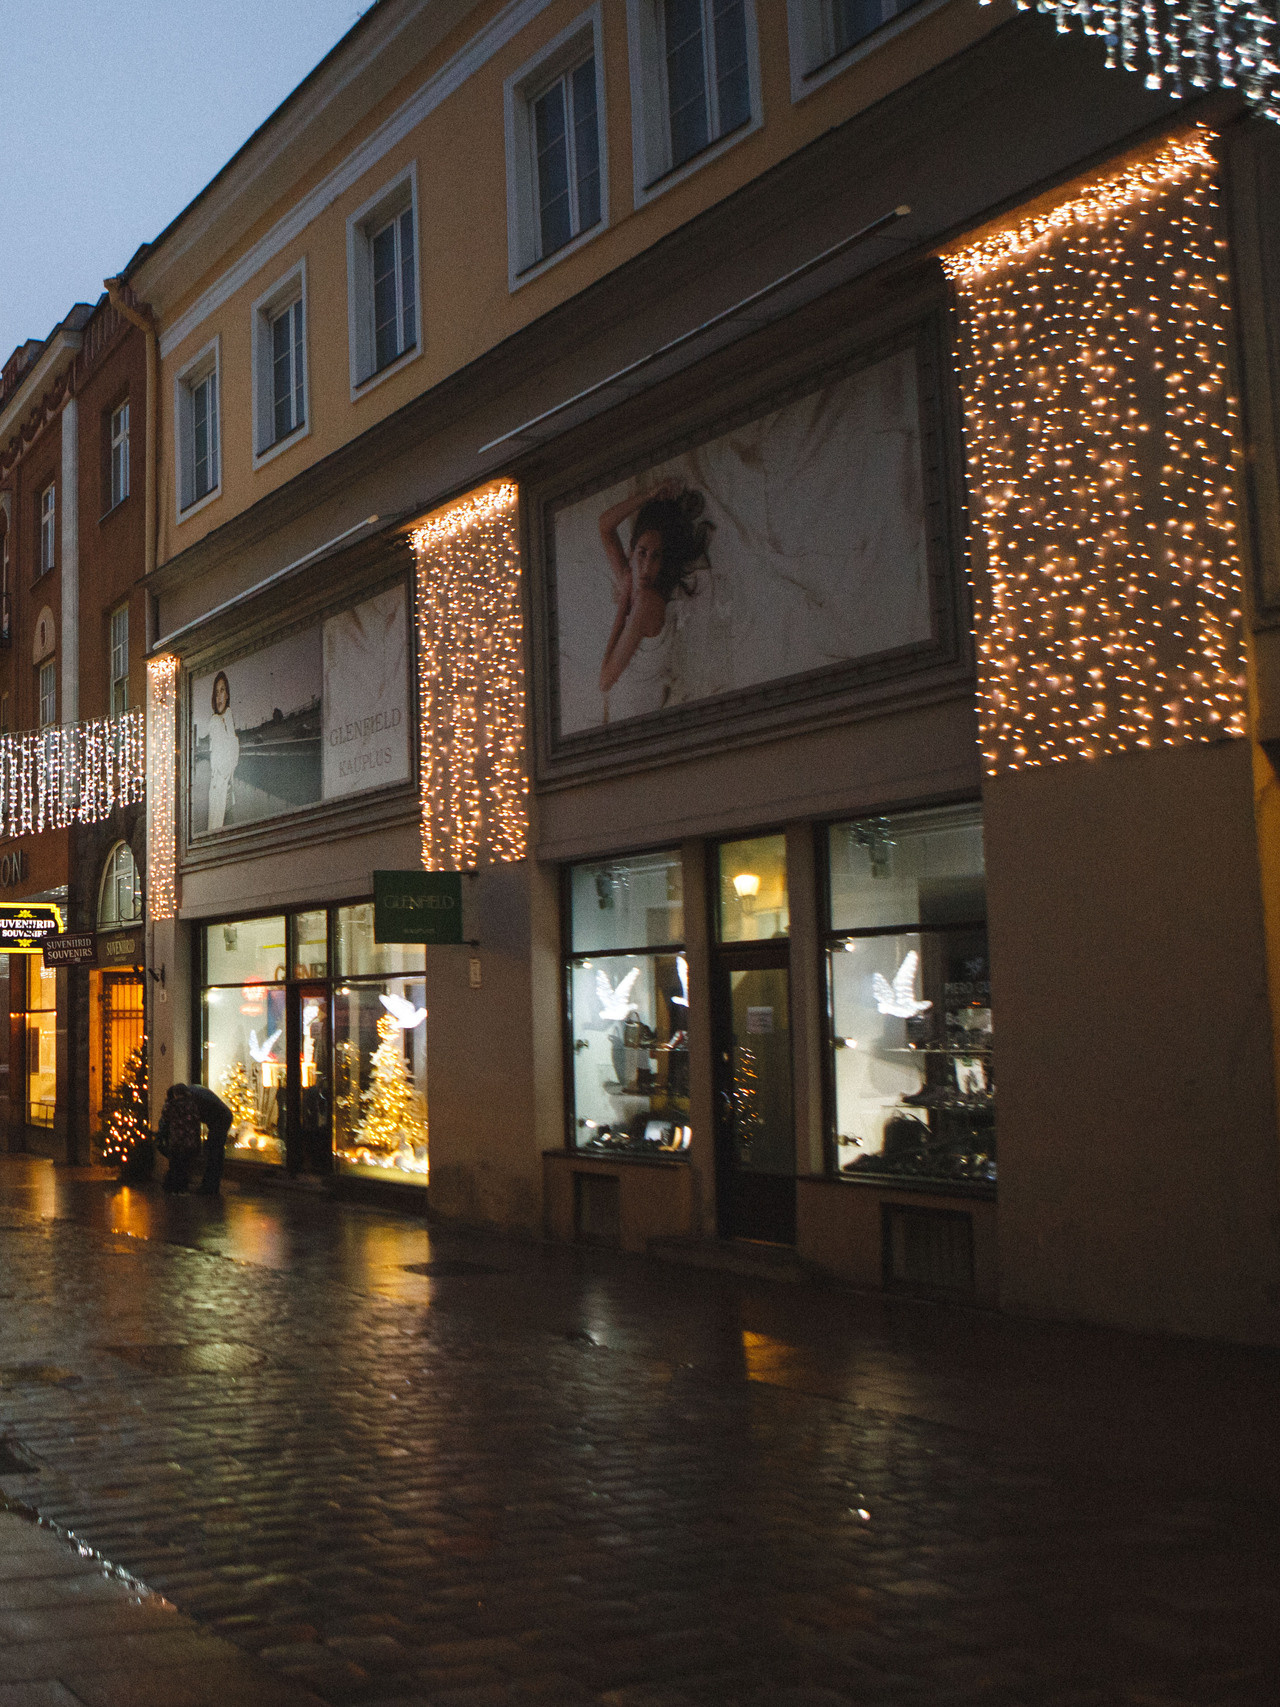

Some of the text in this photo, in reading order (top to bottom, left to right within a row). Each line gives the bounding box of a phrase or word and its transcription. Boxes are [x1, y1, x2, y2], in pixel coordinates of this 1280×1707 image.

[329, 708, 402, 746] GLENFIELD
[338, 747, 393, 778] KAUPLUS
[383, 895, 455, 909] GLENFIELD
[46, 938, 92, 950] SUVENIIRID
[47, 949, 93, 960] SOUVENIRS
